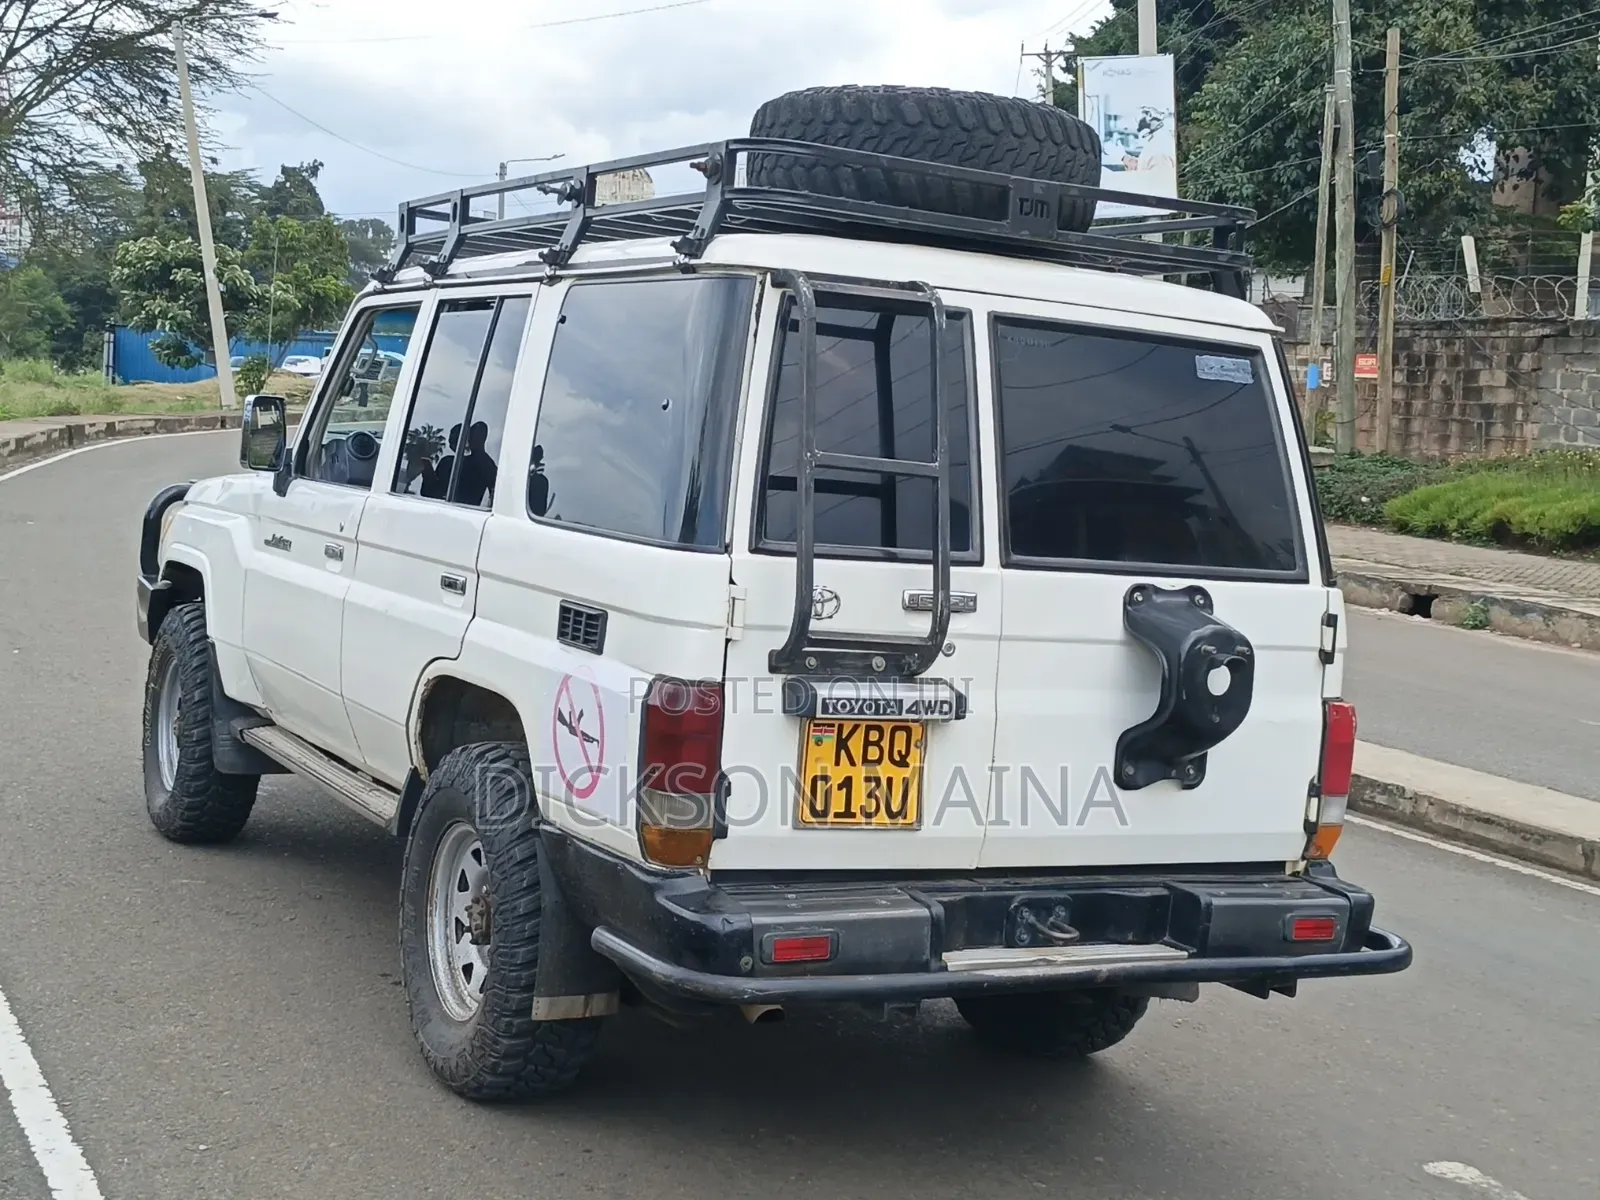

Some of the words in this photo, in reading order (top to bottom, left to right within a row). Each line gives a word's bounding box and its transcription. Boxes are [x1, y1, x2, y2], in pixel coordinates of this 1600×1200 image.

[825, 698, 899, 715] TOYOTA
[904, 699, 954, 716] 4WD
[834, 723, 913, 768] KBQ
[809, 774, 910, 820] 013U
